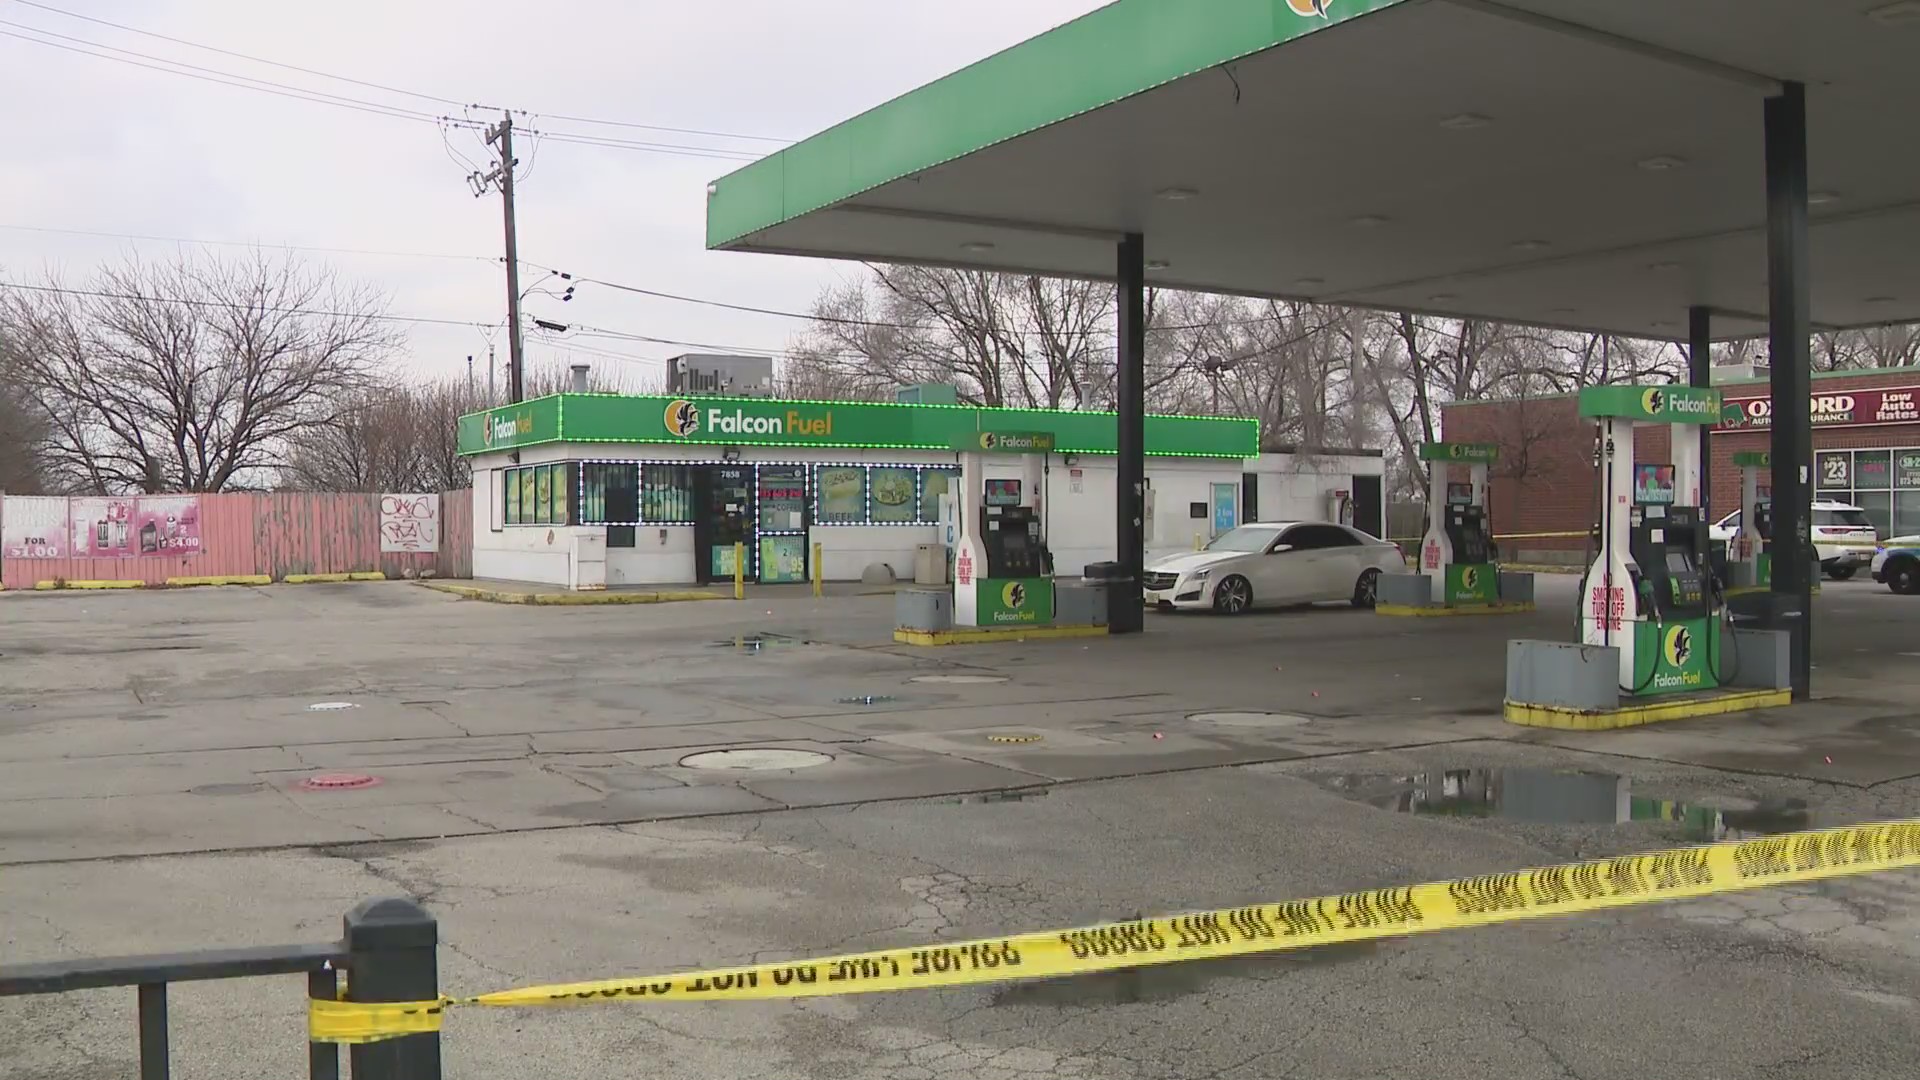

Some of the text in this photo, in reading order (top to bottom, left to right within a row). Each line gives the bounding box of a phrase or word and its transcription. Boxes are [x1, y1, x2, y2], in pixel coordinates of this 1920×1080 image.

[1882, 393, 1912, 402] Low
[1880, 402, 1915, 411] Auto
[708, 408, 832, 435] Falcon Fuel
[1876, 411, 1919, 420] Rates
[494, 415, 516, 439] Falcon
[1824, 461, 1847, 479] $23
[24, 537, 46, 545] FOR
[169, 537, 199, 548] $4.00
[1592, 601, 1625, 616] TUR OFF
[1596, 616, 1621, 630] ENINE
